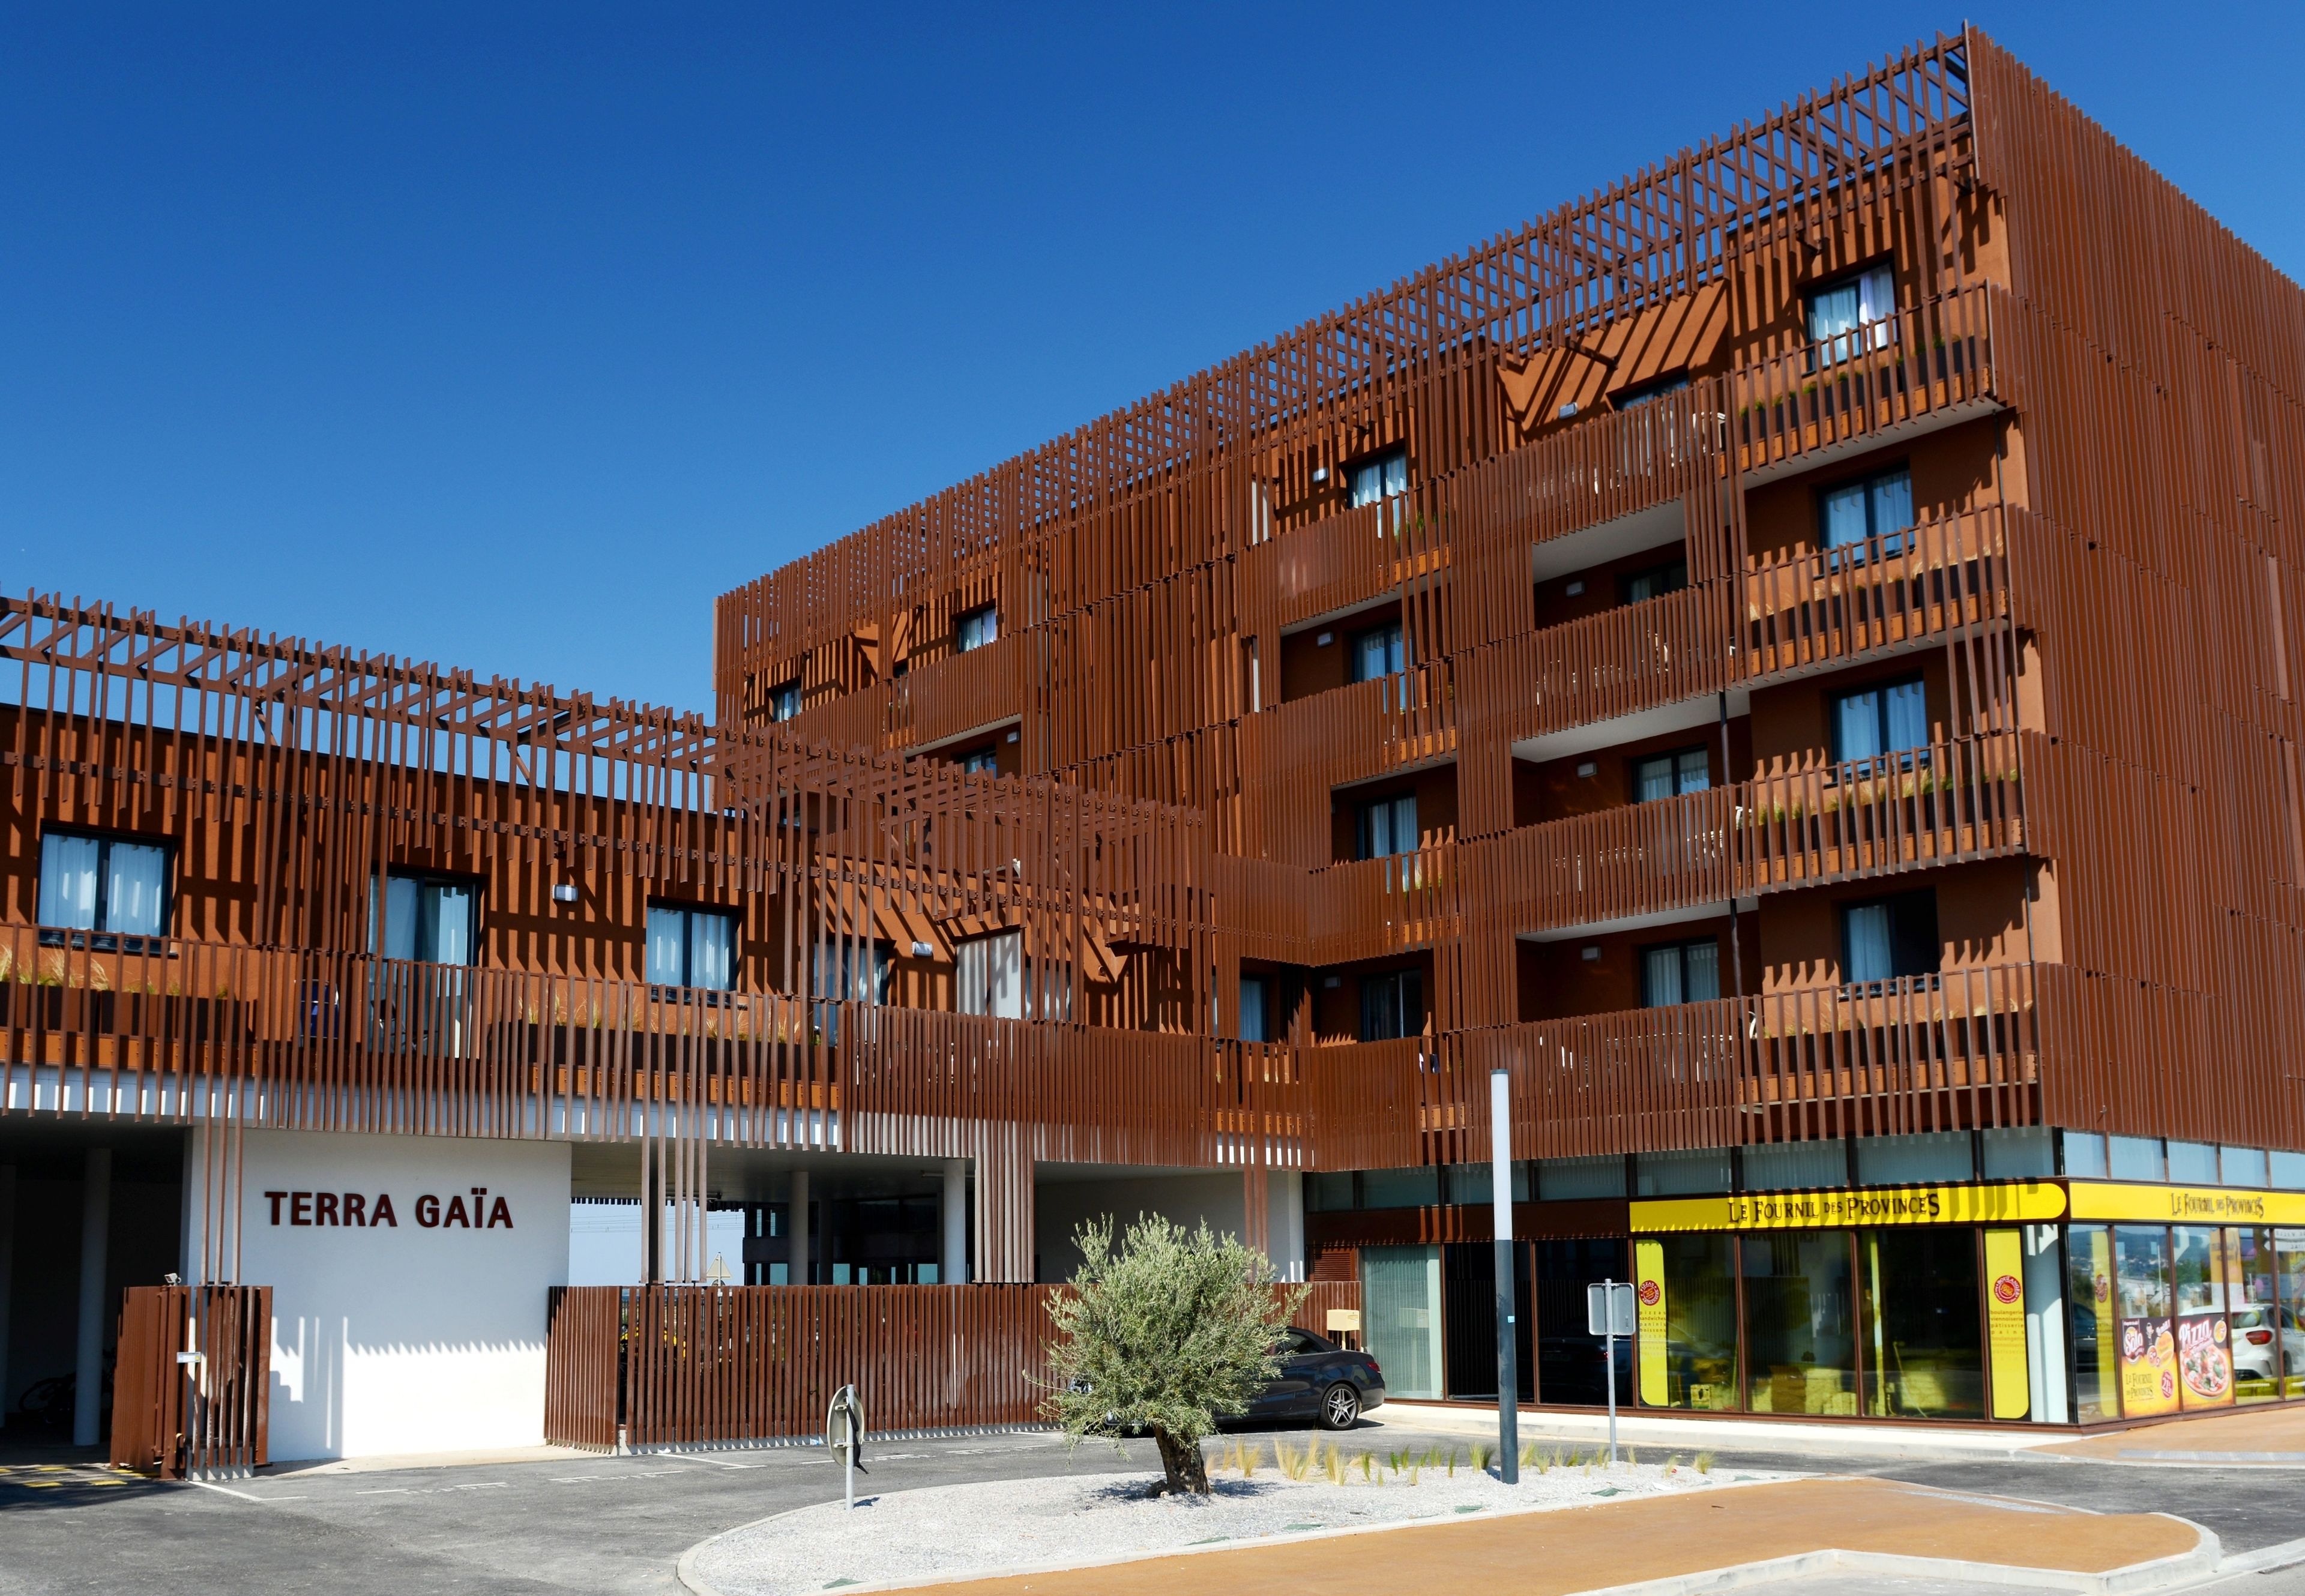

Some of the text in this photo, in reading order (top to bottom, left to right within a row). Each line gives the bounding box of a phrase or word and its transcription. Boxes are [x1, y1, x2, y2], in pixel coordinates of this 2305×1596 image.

[265, 1187, 514, 1229] TERRA GAÏA
[2178, 1319, 2212, 1354] Pizza
